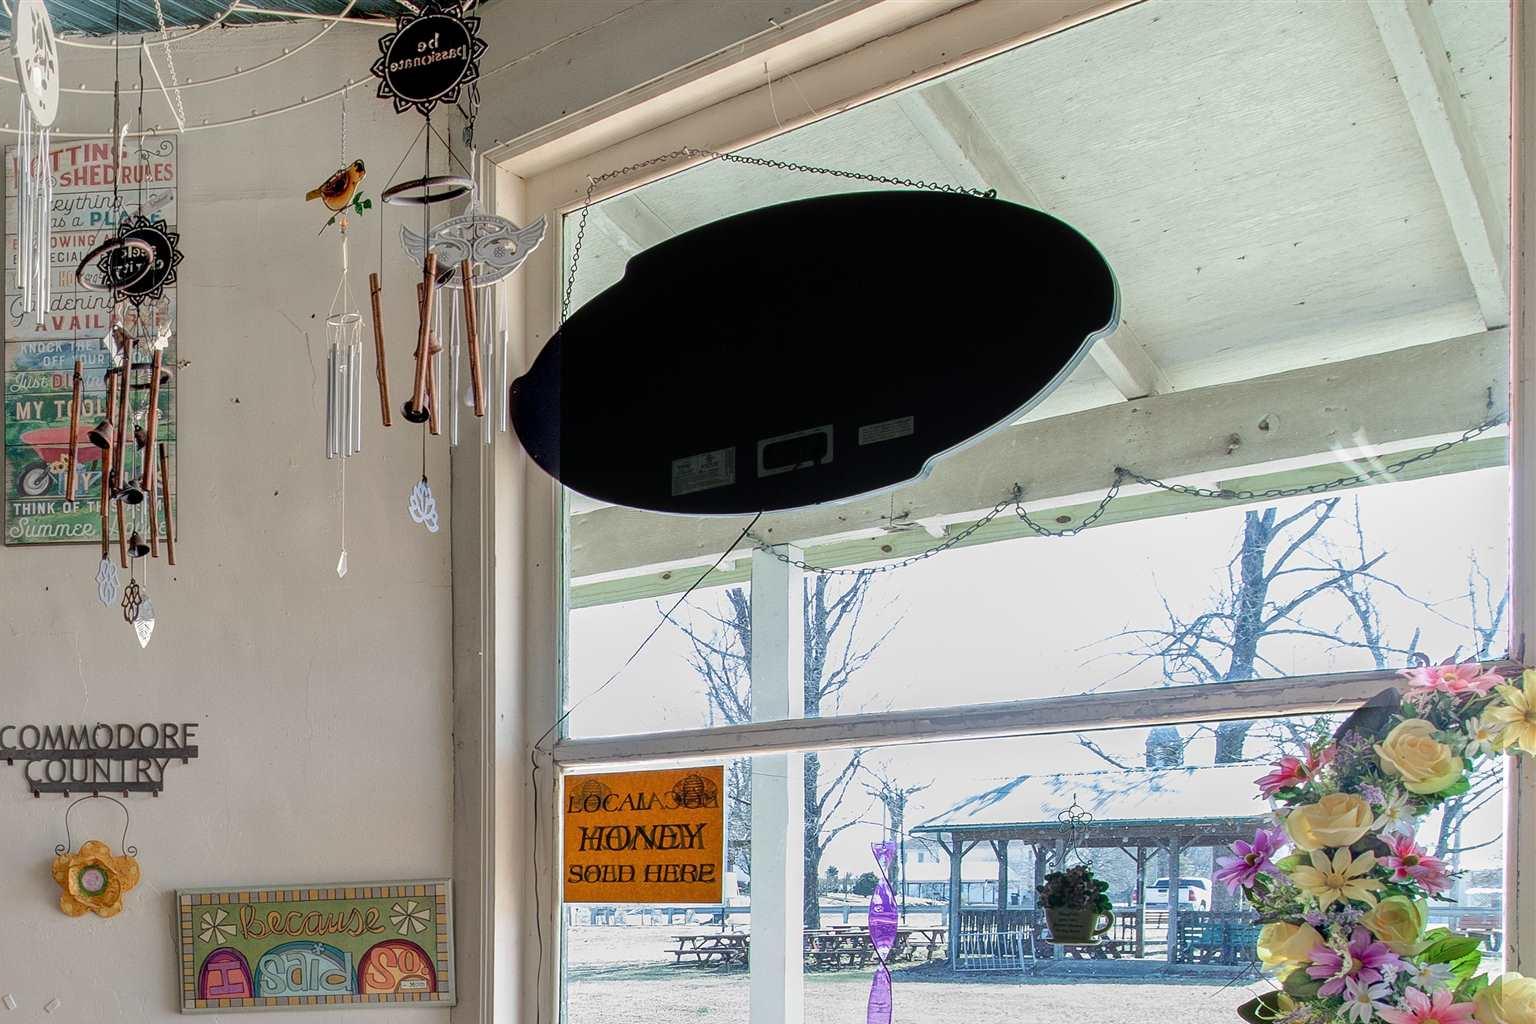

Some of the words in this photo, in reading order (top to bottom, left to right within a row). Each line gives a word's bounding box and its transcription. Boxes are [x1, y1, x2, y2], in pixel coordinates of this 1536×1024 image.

[59, 165, 116, 187] SHED
[89, 209, 161, 227] PLAE
[16, 401, 49, 420] MY
[14, 502, 56, 515] THINK
[63, 501, 80, 514] OF
[24, 758, 170, 784] COUNTRY
[577, 823, 709, 851] HONEY
[568, 864, 635, 884] SOLD
[642, 863, 716, 883] HERE
[239, 904, 385, 940] Because
[207, 960, 245, 996] I
[258, 951, 353, 995] Said
